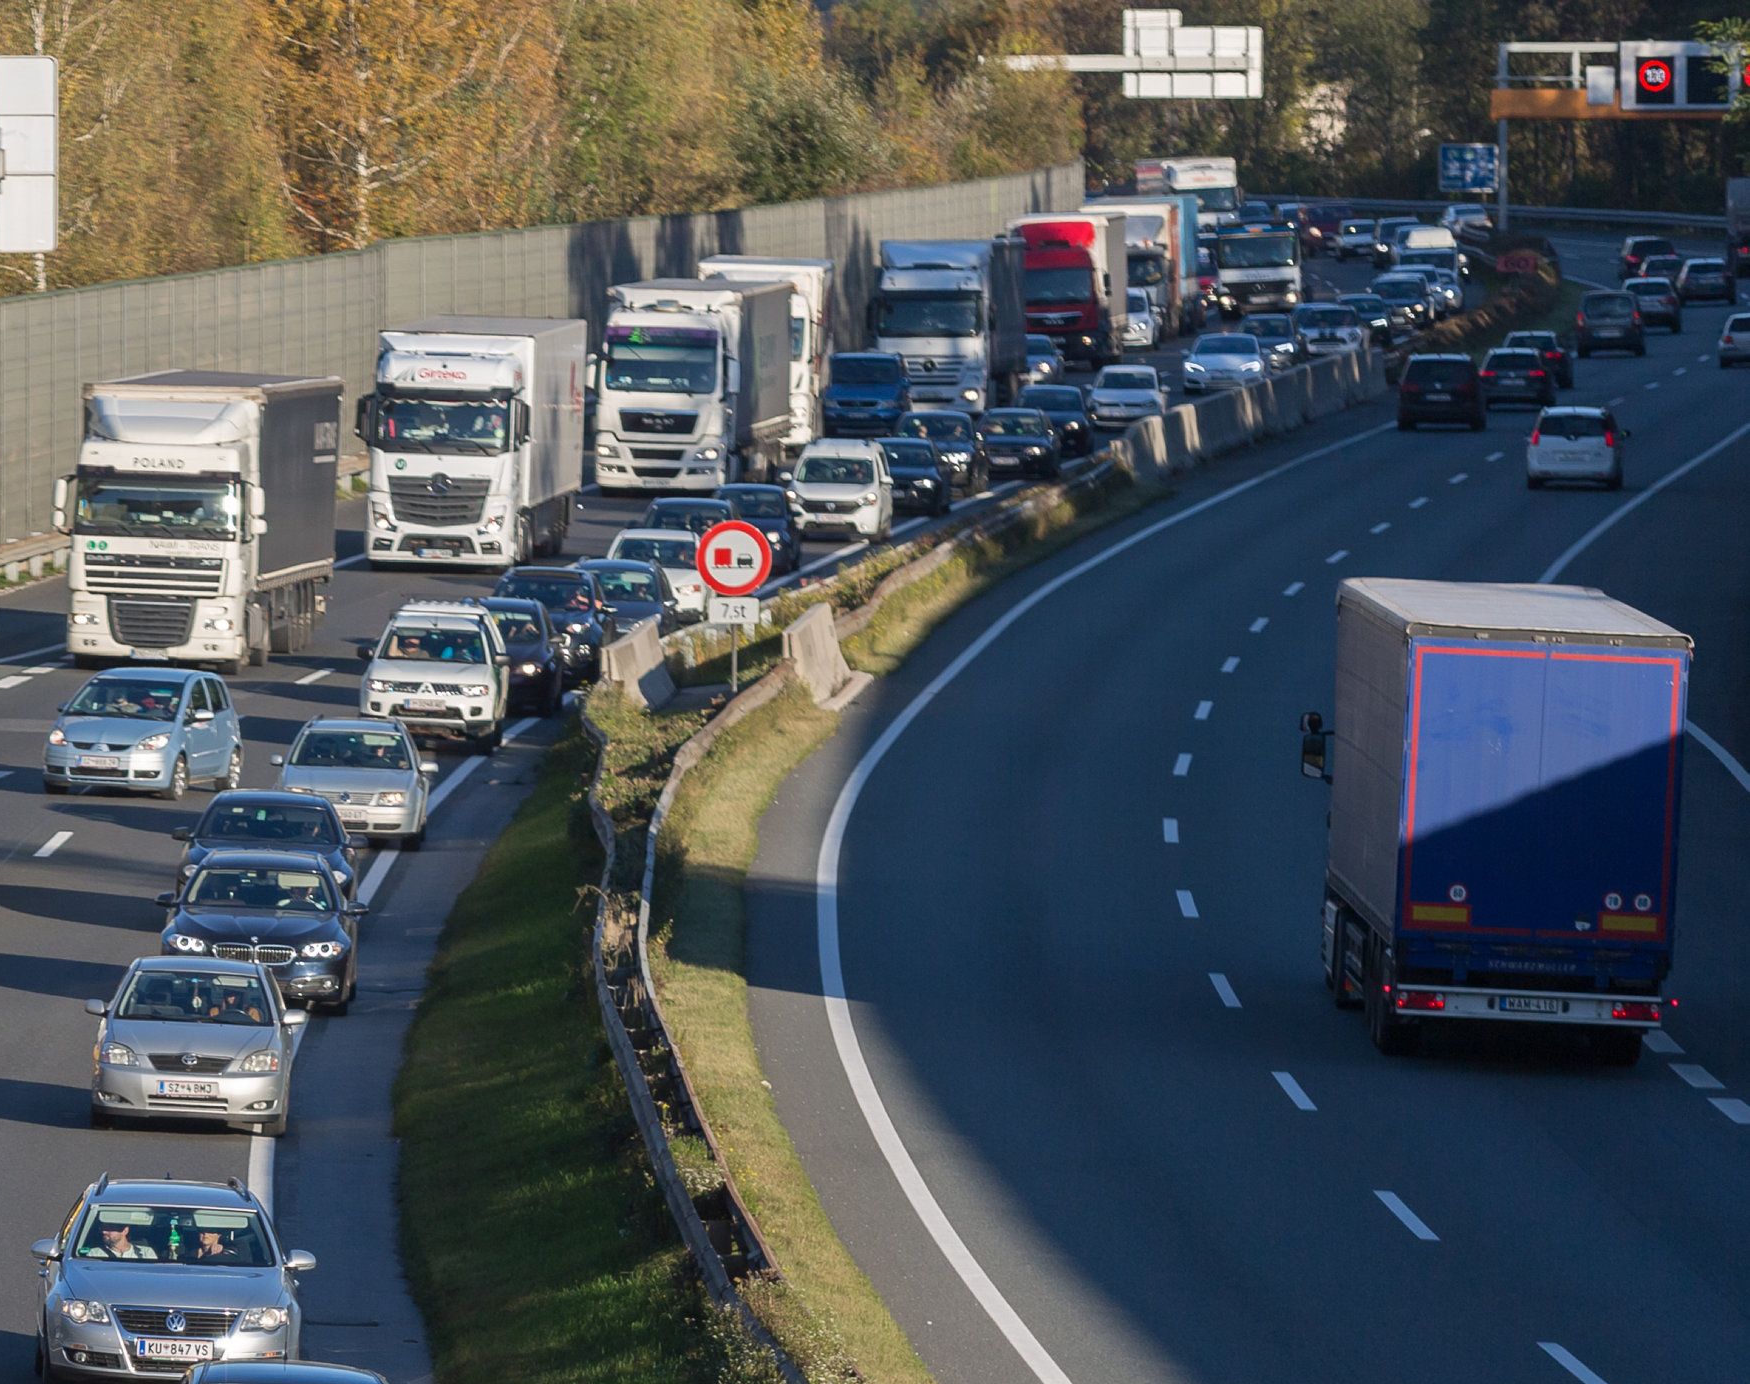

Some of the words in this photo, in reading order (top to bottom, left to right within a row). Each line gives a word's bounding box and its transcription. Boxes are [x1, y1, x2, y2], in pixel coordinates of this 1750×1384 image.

[132, 457, 186, 469] POLAND
[168, 1083, 179, 1092] SZ
[148, 1343, 162, 1354] KU
[170, 1344, 191, 1355] 847
[195, 1344, 208, 1356] VS
